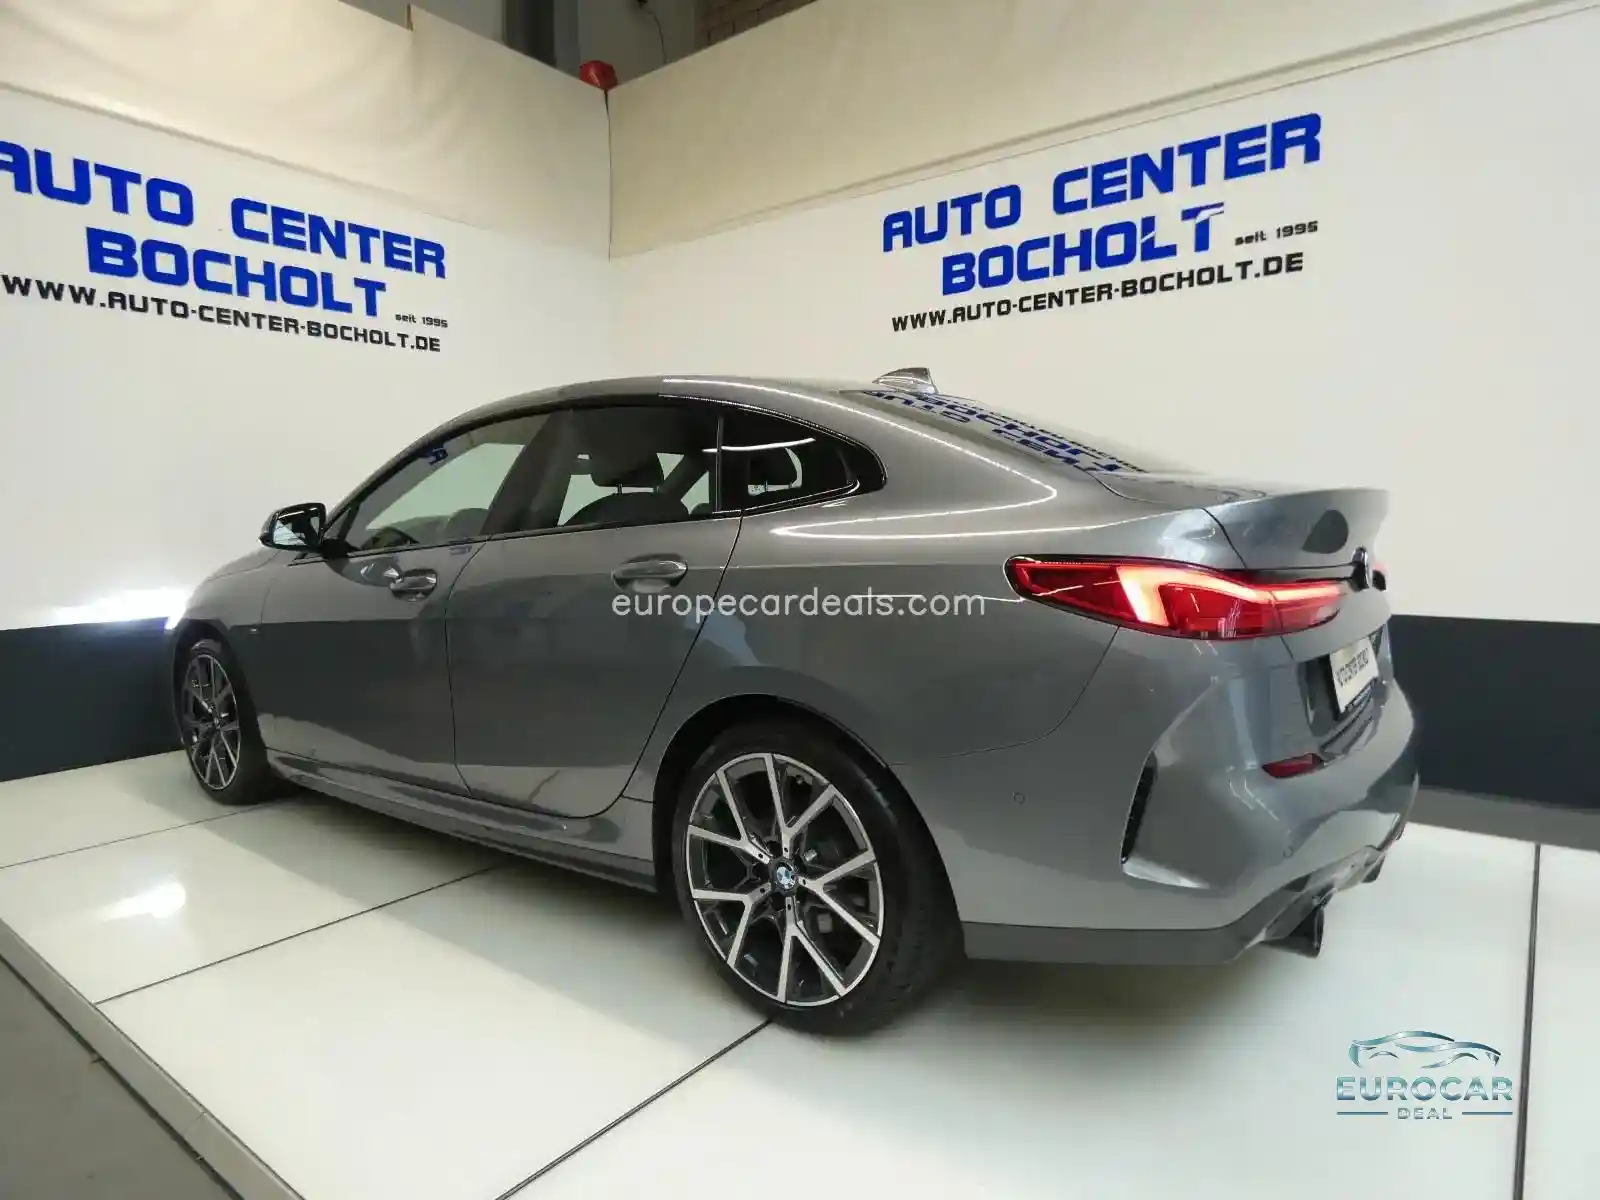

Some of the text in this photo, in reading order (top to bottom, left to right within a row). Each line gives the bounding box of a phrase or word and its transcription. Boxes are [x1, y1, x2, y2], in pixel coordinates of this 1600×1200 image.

[0, 140, 447, 279] AUTO CENTER
[884, 113, 1322, 253] AUTO CENTER
[86, 227, 387, 318] BOCHOLT
[942, 202, 1225, 296] BOCHOLT
[1235, 220, 1319, 246] seit 1995
[395, 313, 449, 328] seit 1995
[891, 251, 1304, 332] WWW.AUTO-CENTER-BOCHOLT.DE
